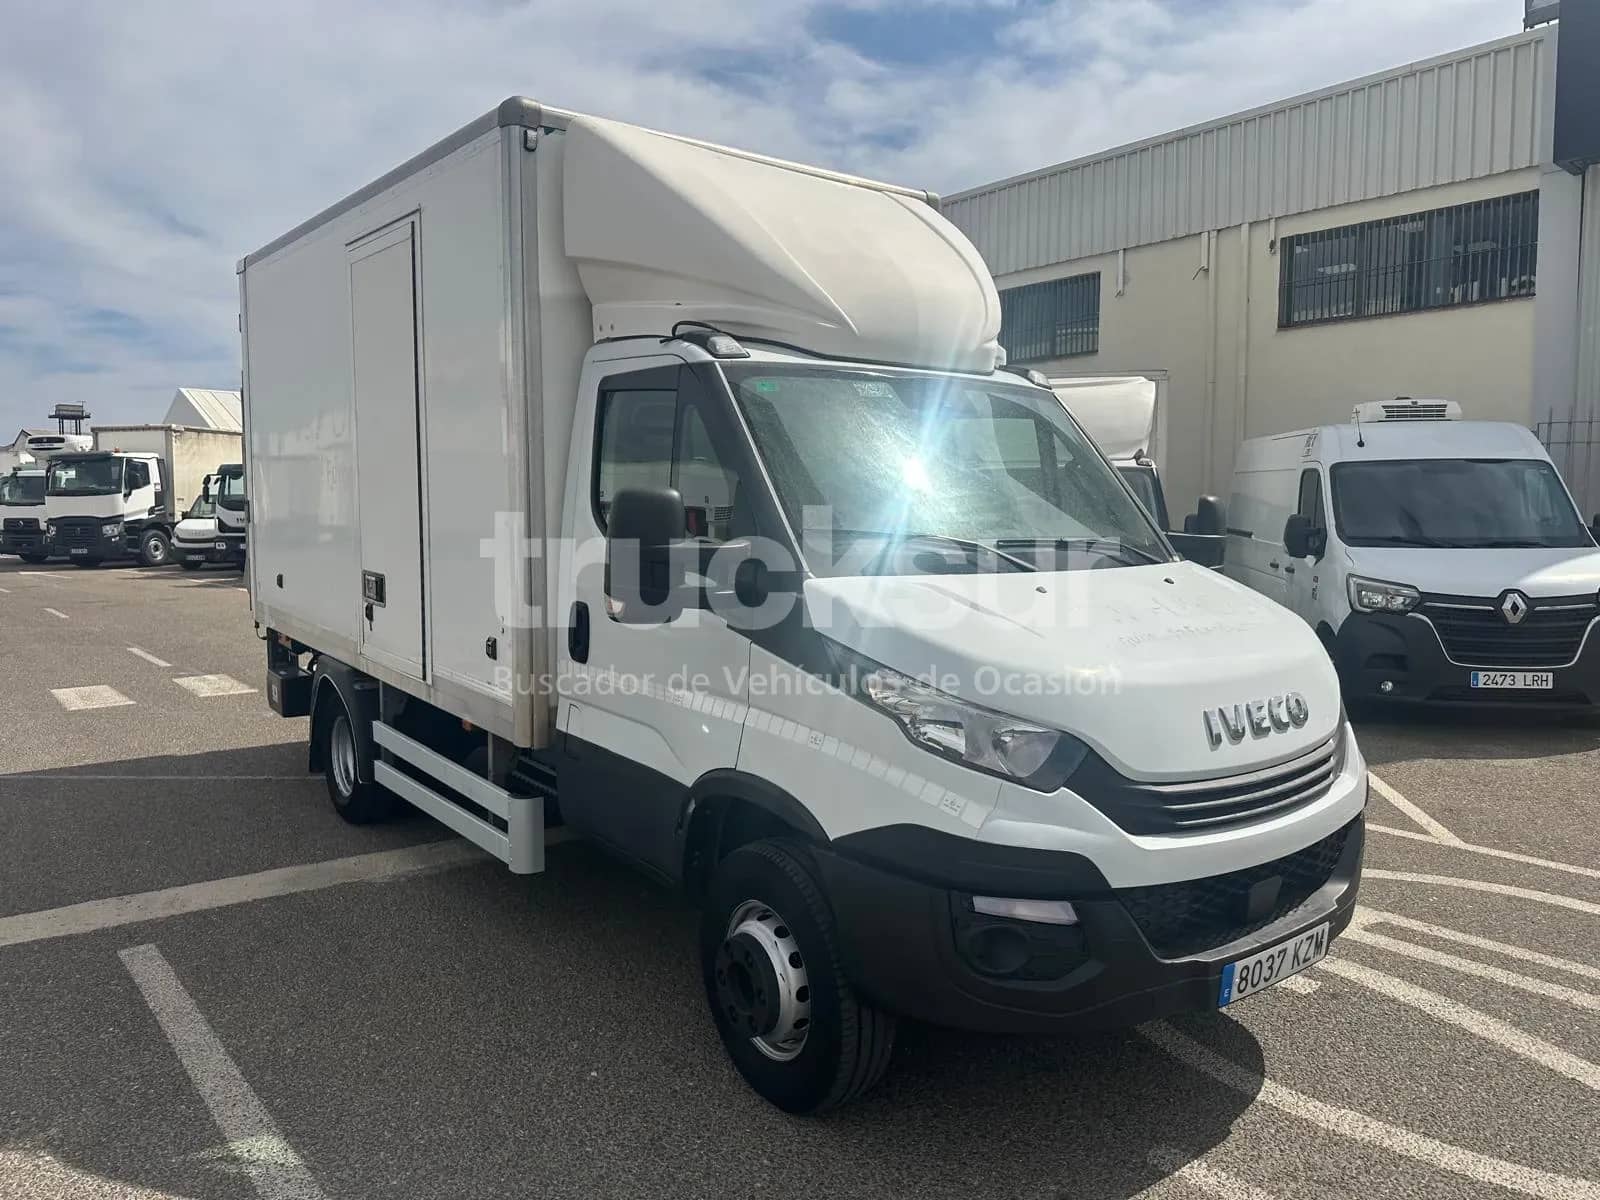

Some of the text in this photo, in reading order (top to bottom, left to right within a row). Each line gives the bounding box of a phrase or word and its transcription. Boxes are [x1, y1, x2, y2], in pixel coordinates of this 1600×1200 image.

[1482, 674, 1549, 687] 2473 LRH
[1203, 692, 1309, 751] IVECO
[1237, 949, 1287, 994] 8037
[1291, 929, 1325, 970] KZM
